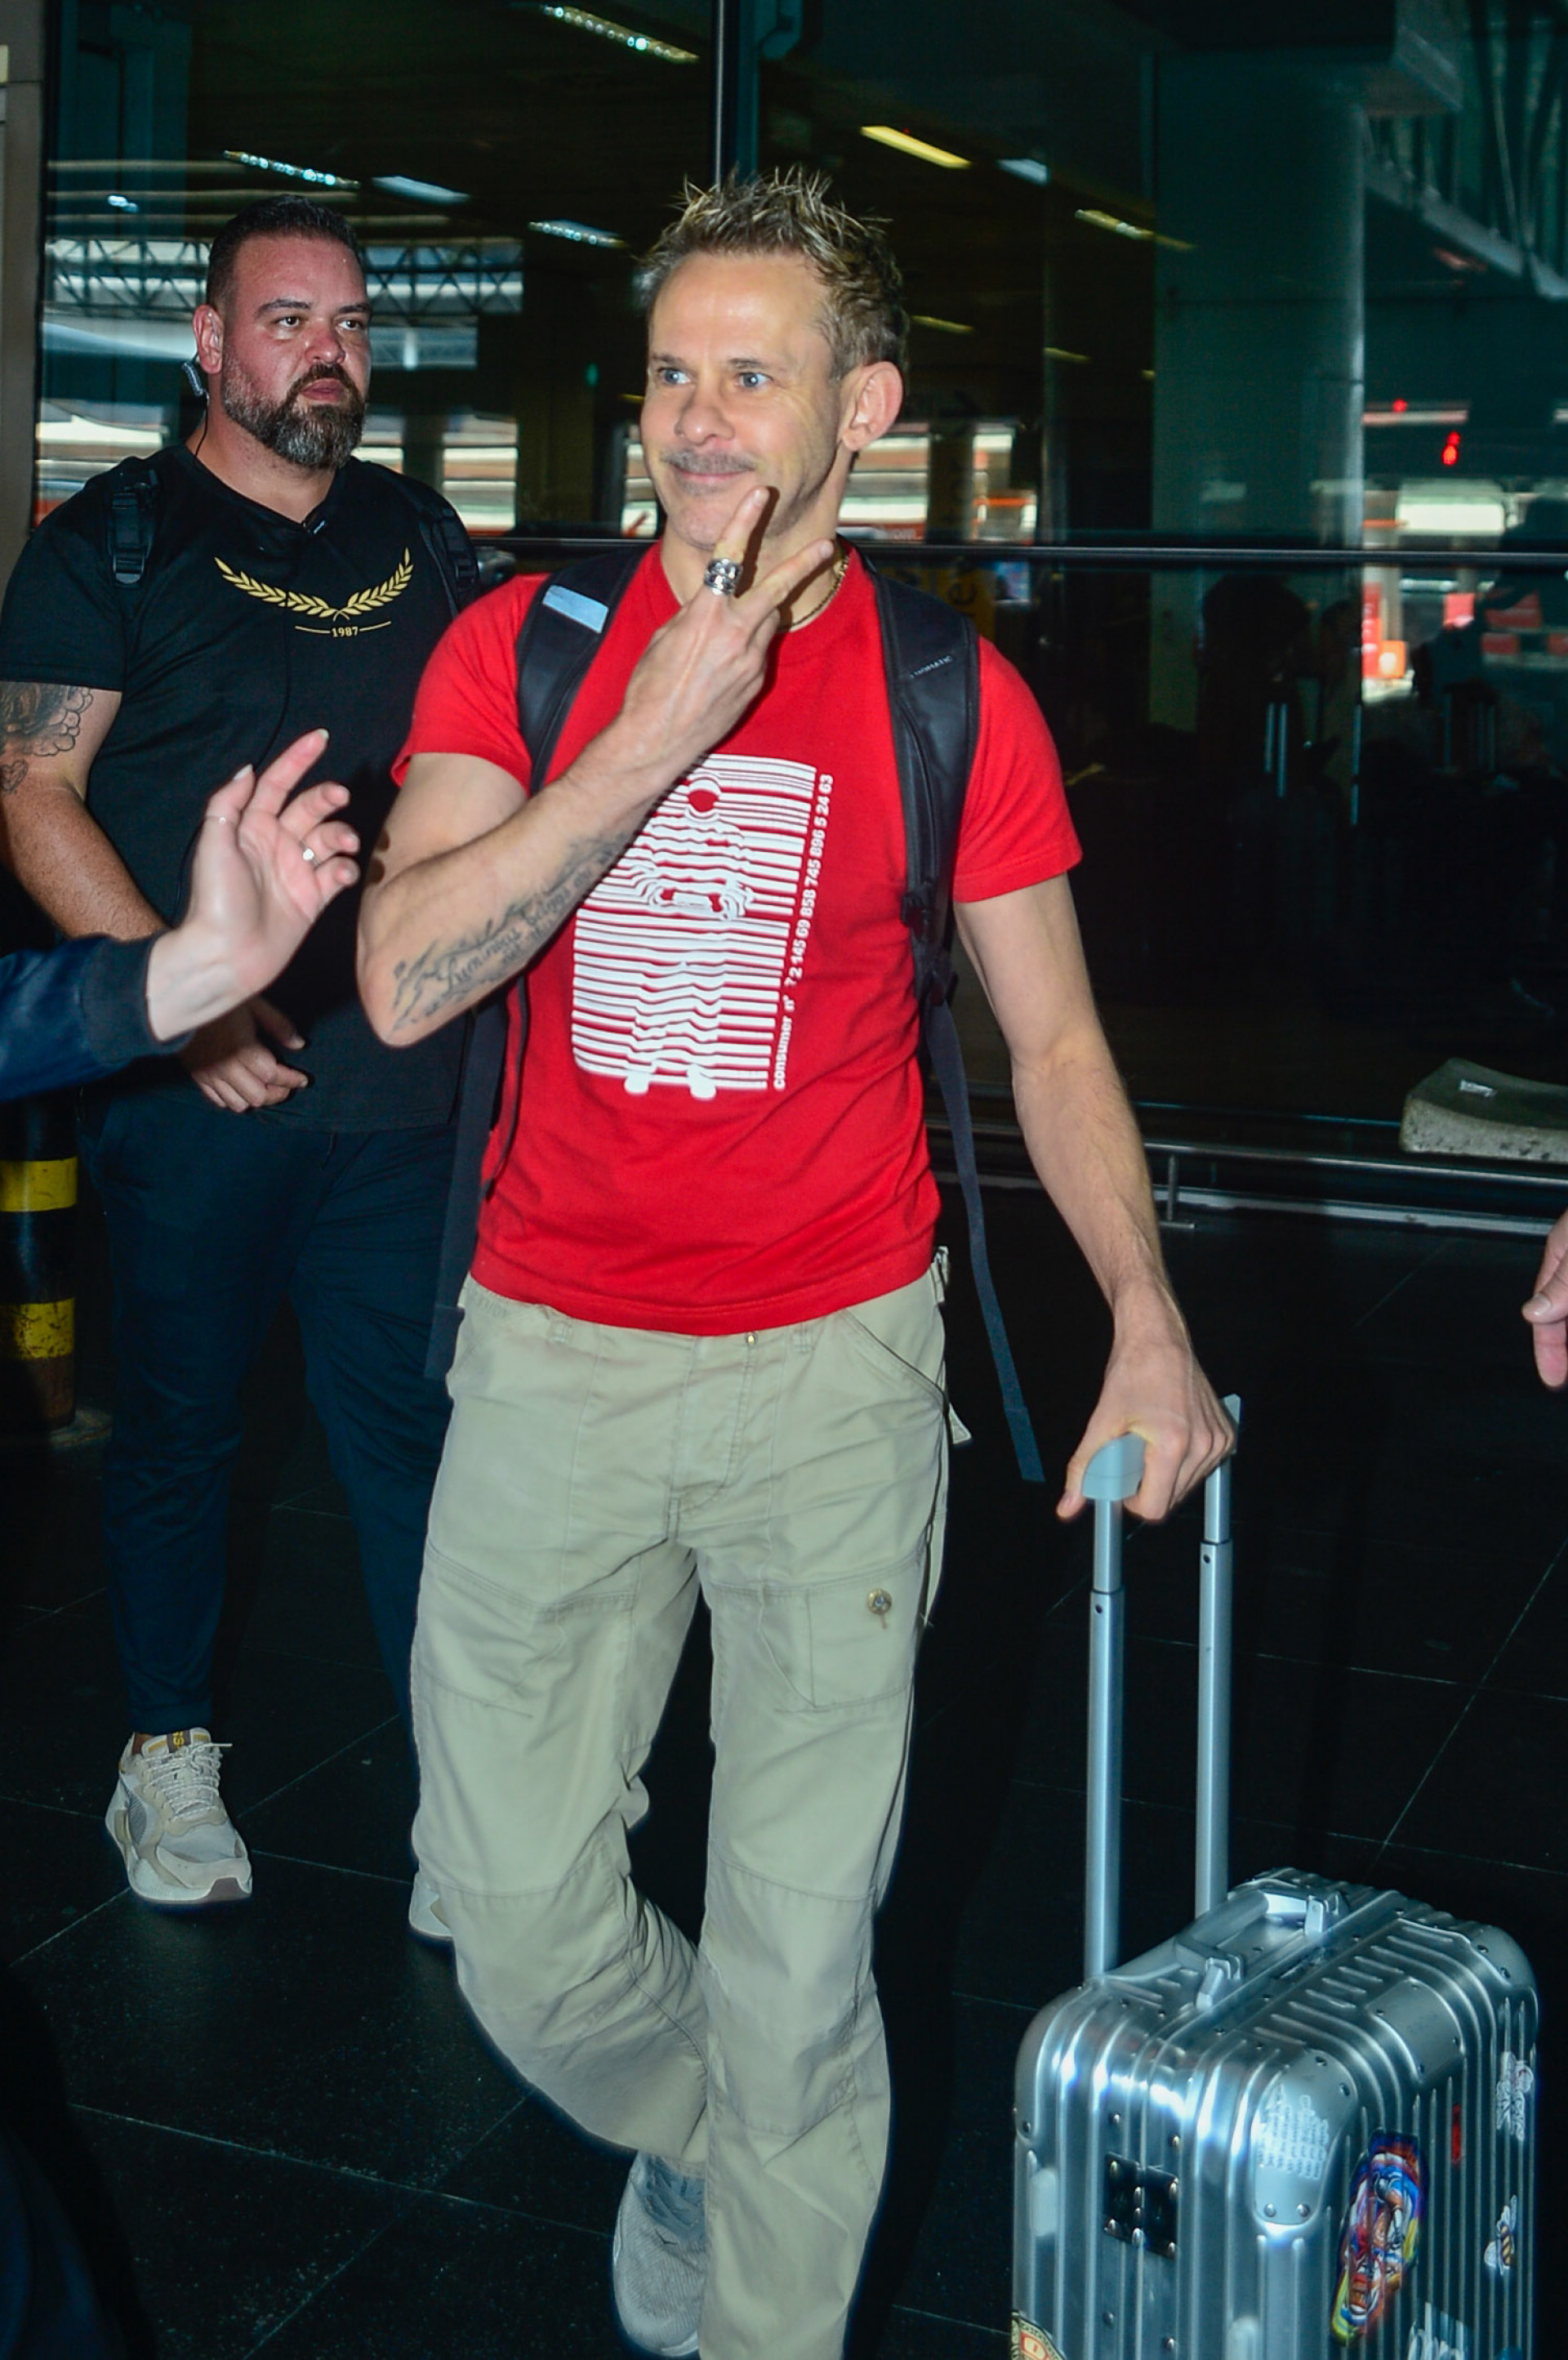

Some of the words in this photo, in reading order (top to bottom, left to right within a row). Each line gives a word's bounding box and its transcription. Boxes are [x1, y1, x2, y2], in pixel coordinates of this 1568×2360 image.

[332, 626, 359, 637] 1987
[791, 939, 807, 965] 145
[804, 859, 822, 887] 745
[815, 795, 830, 815] 24
